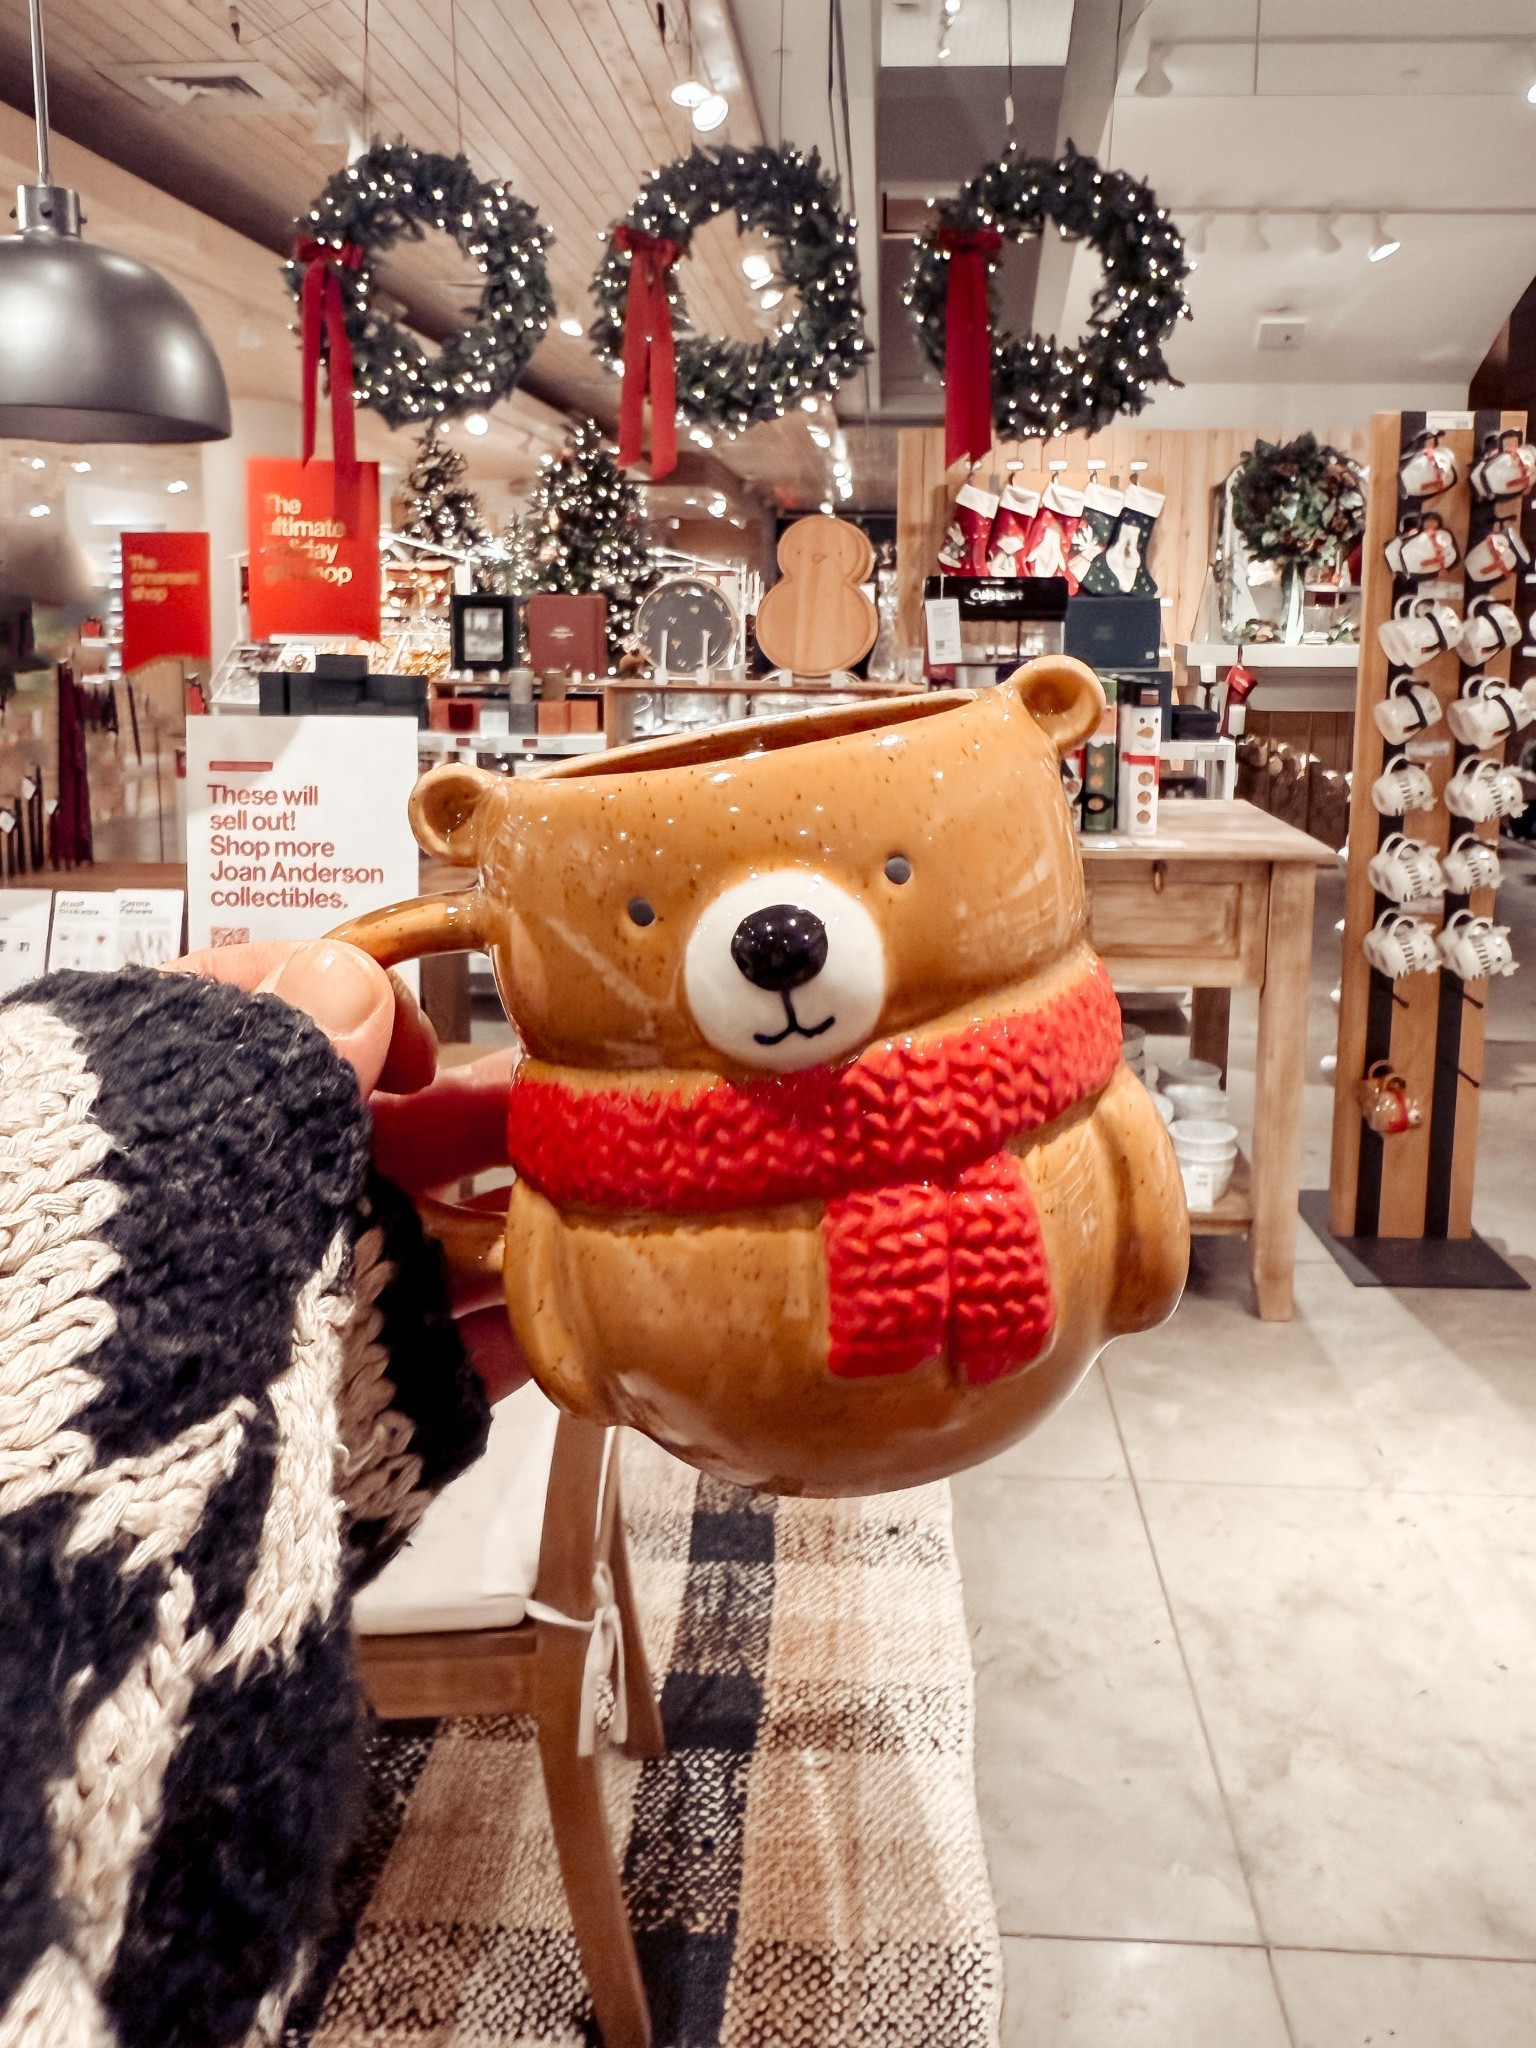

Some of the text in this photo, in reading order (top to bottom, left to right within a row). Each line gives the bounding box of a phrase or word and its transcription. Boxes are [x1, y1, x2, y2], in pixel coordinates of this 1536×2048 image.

[207, 784, 319, 807] These will
[209, 809, 296, 832] sell out!
[210, 834, 336, 861] Shop more
[209, 859, 385, 885] Joan Anderson
[210, 886, 349, 909] collectibles.
